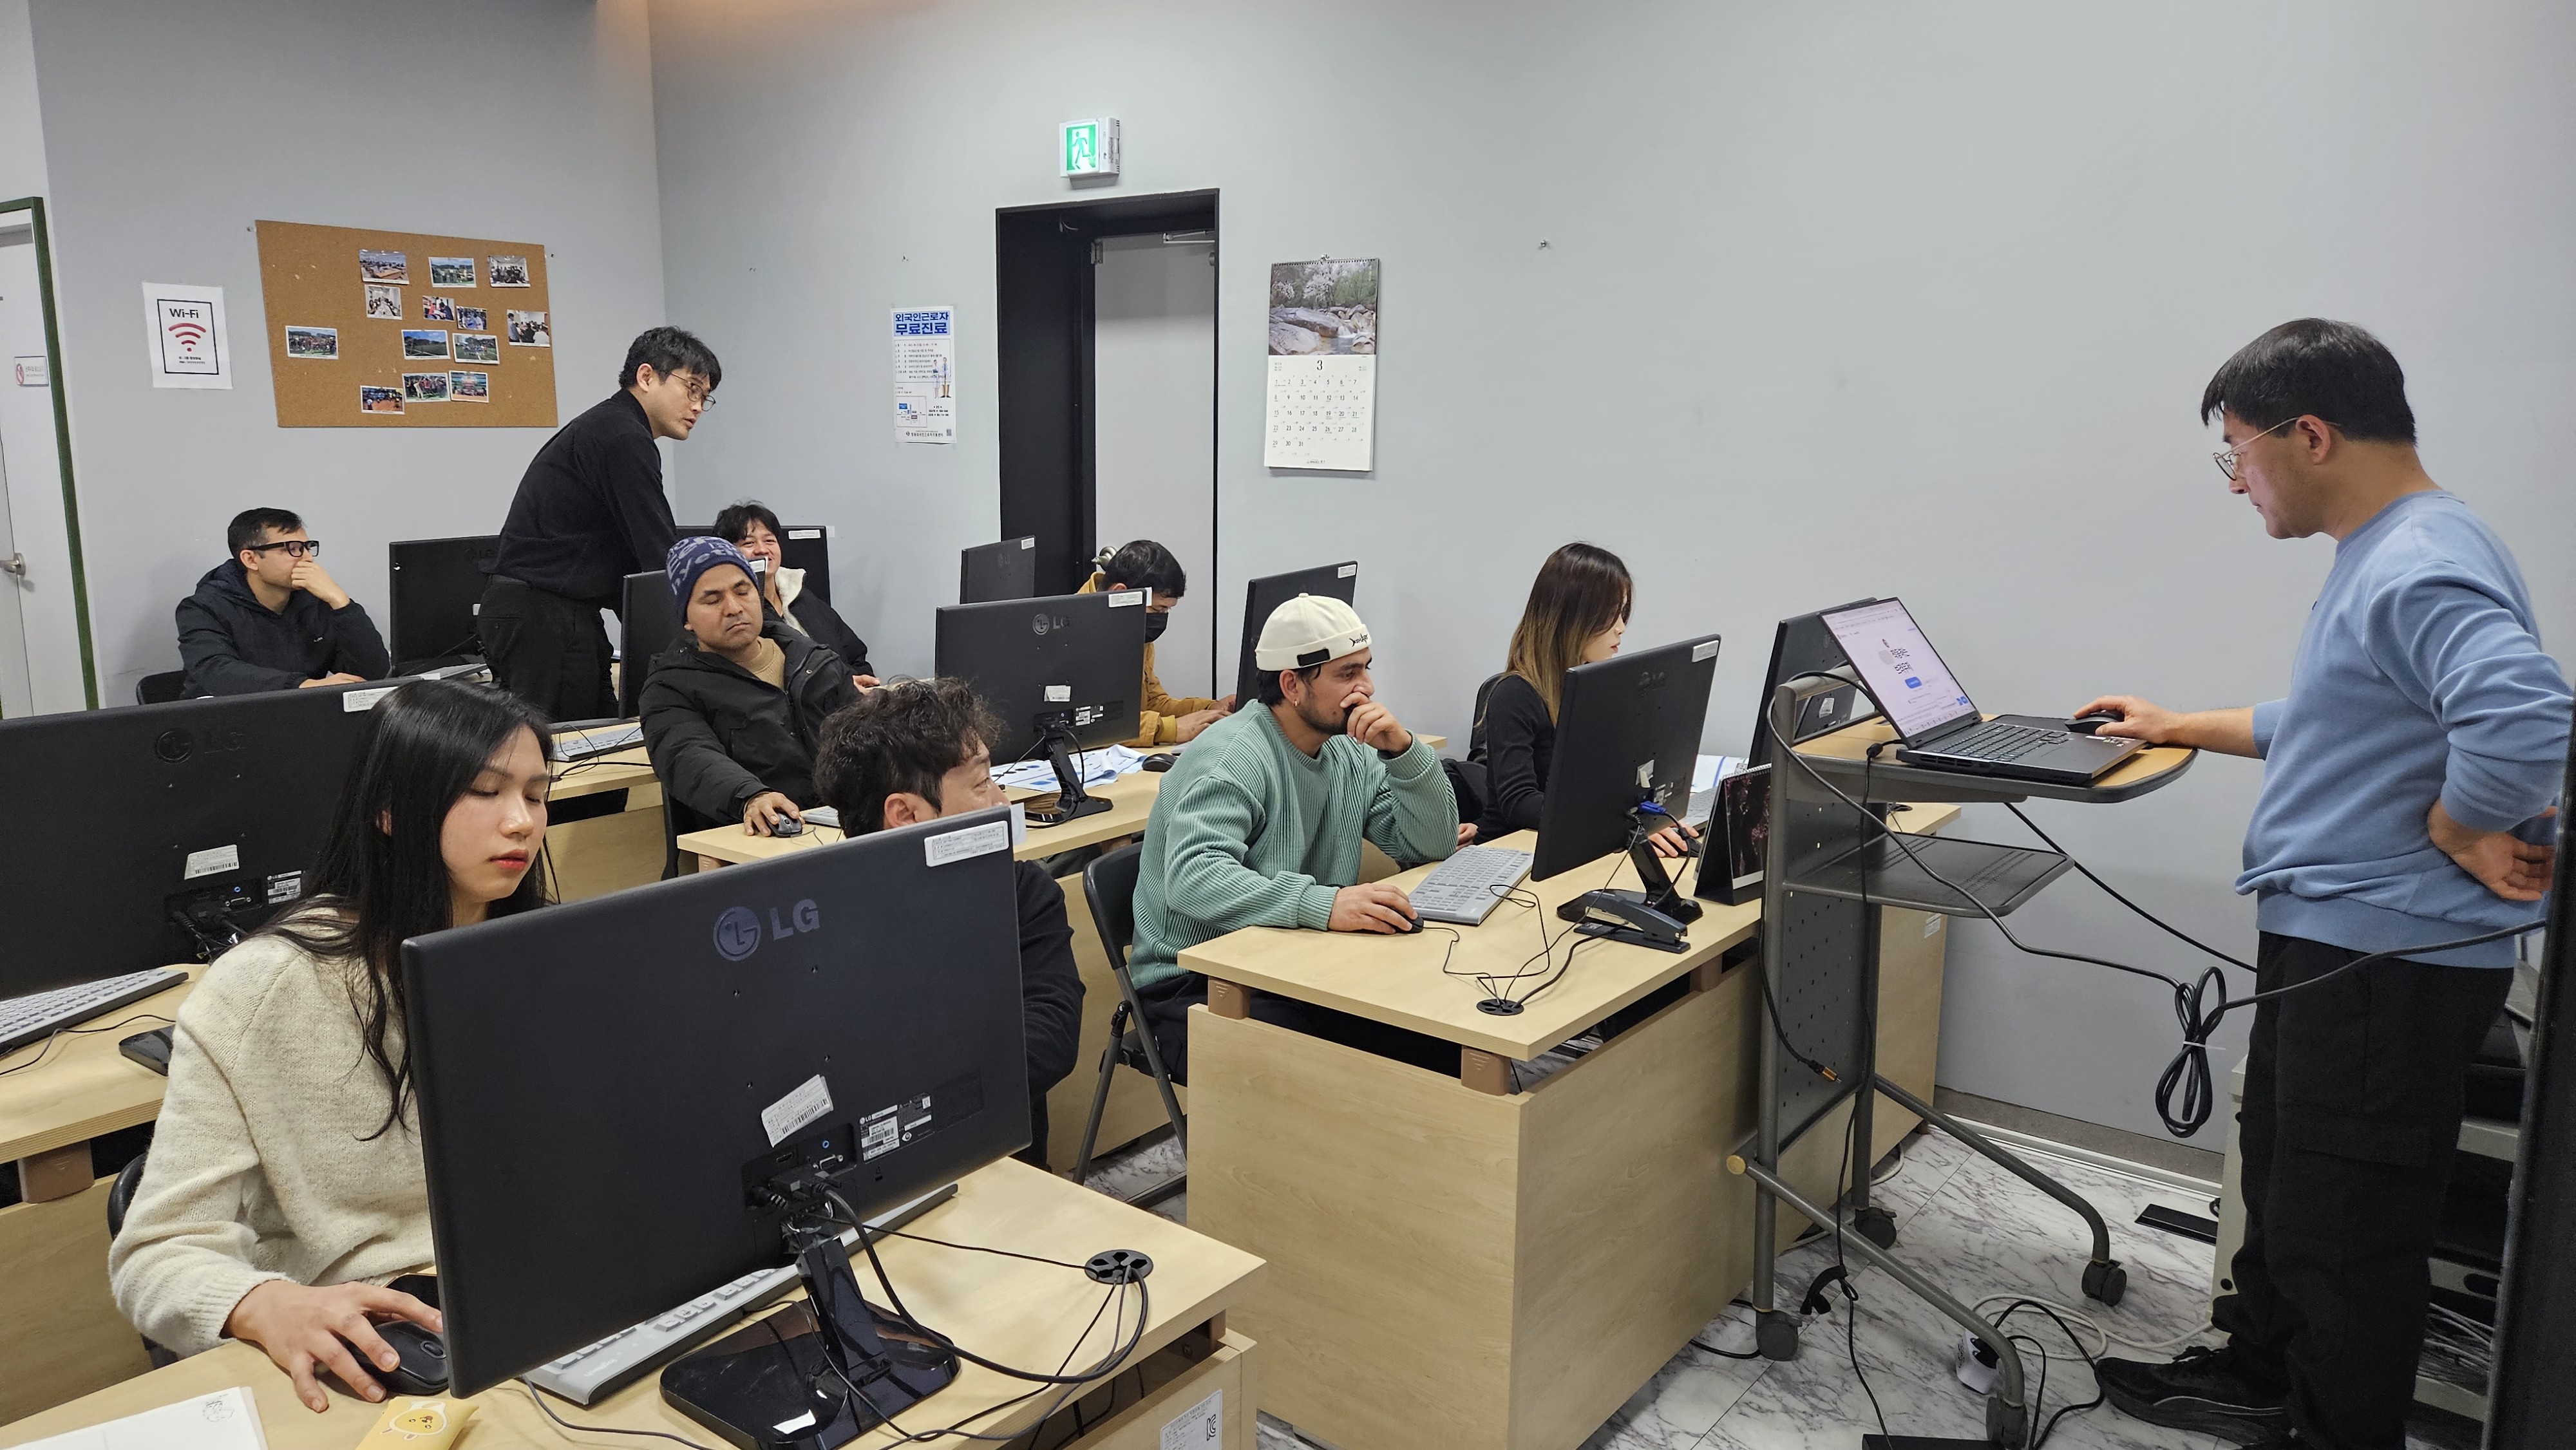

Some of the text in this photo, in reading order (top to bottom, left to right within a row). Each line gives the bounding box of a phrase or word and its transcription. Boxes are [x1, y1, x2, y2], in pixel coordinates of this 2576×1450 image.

[169, 308, 199, 319] Wi-Fi
[895, 312, 949, 322] 외국인근로자
[895, 322, 948, 335] 무료진료
[1316, 360, 1323, 371] 3
[1052, 614, 1071, 630] LG
[769, 899, 820, 941] LG
[865, 1115, 872, 1123] LG
